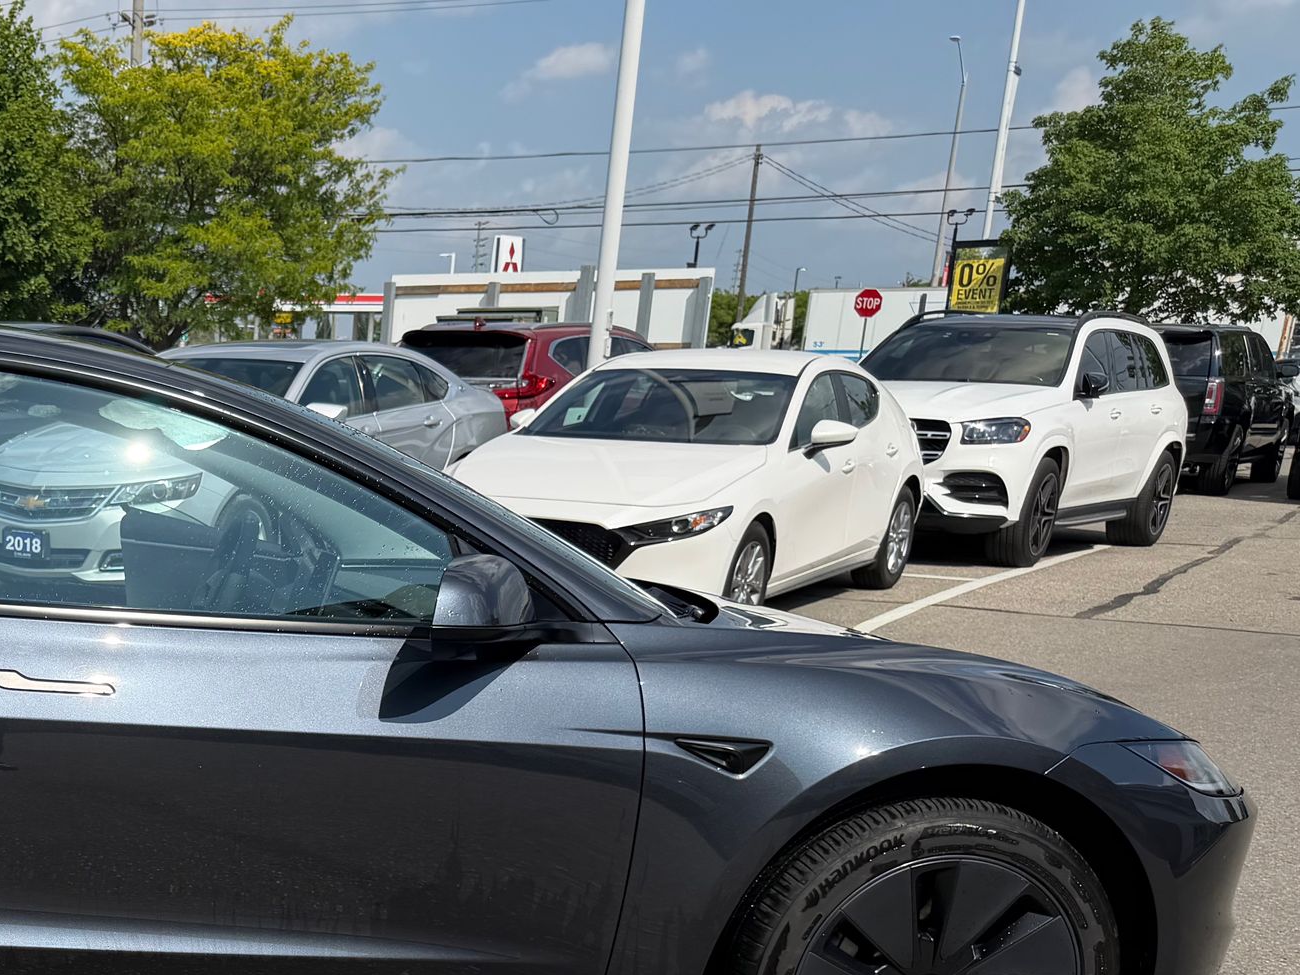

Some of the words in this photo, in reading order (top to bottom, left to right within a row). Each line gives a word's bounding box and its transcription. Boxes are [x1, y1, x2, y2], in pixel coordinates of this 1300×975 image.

[958, 262, 998, 288] 0%
[956, 288, 996, 301] EVENT
[856, 297, 881, 309] STOP
[5, 535, 42, 553] 2018
